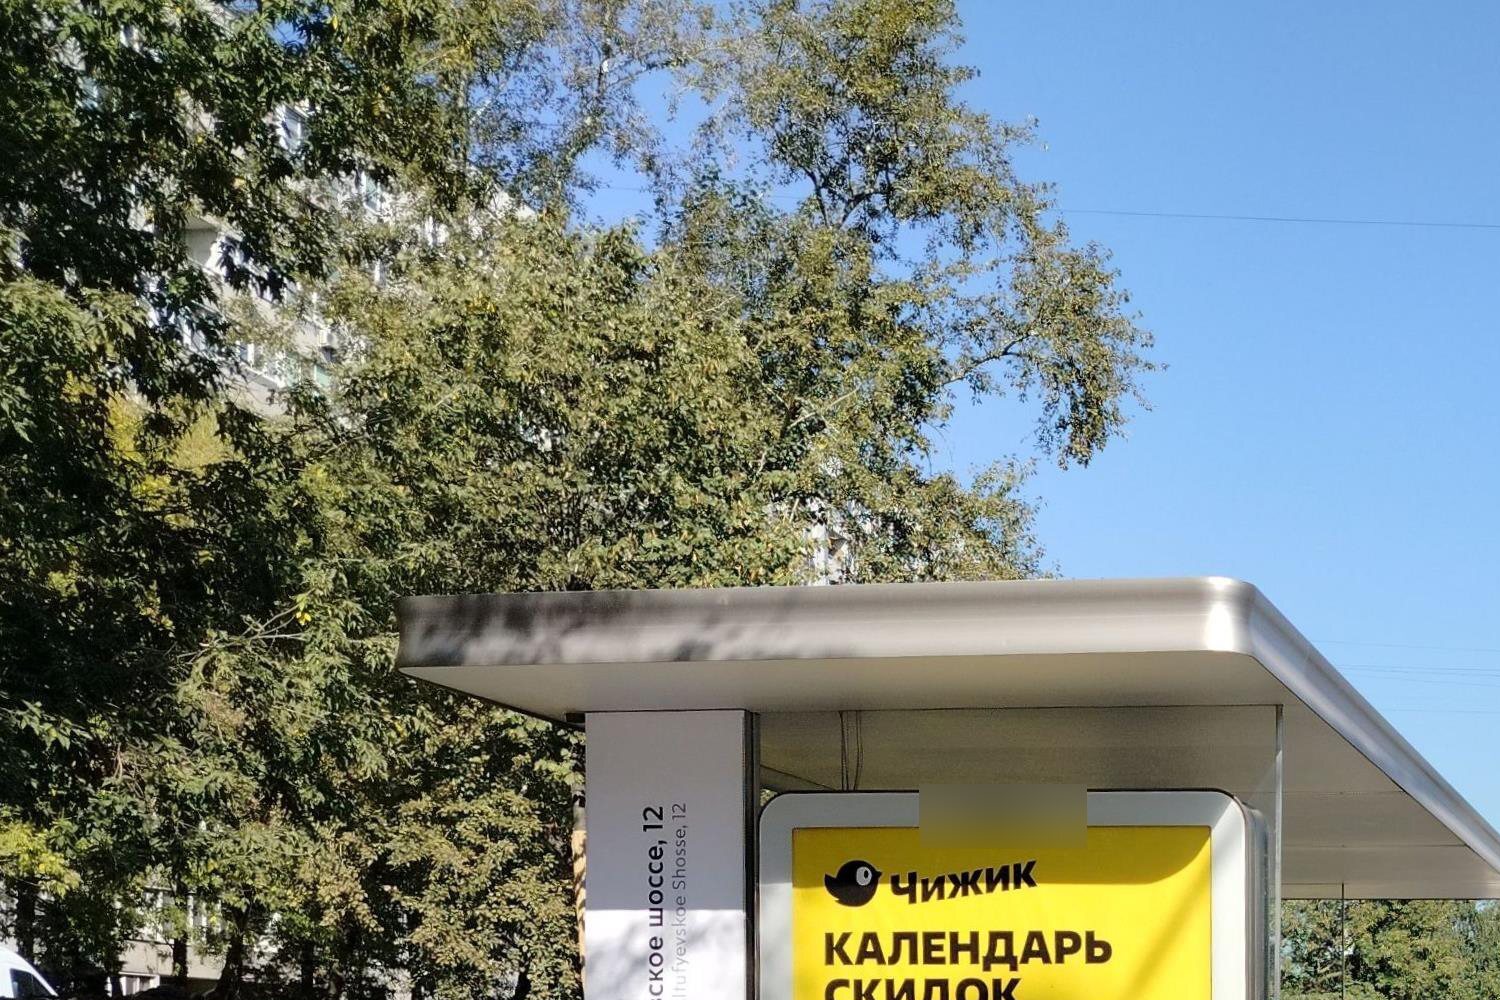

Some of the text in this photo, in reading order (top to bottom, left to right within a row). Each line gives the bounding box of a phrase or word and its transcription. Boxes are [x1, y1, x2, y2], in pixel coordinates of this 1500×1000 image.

[643, 805, 664, 832] 12
[672, 803, 687, 820] 12
[672, 825, 689, 890] Shosse,
[648, 840, 668, 926] шоссе,
[890, 860, 1037, 904] Чижик
[824, 930, 1113, 972] КАЛЕНДАРЬ
